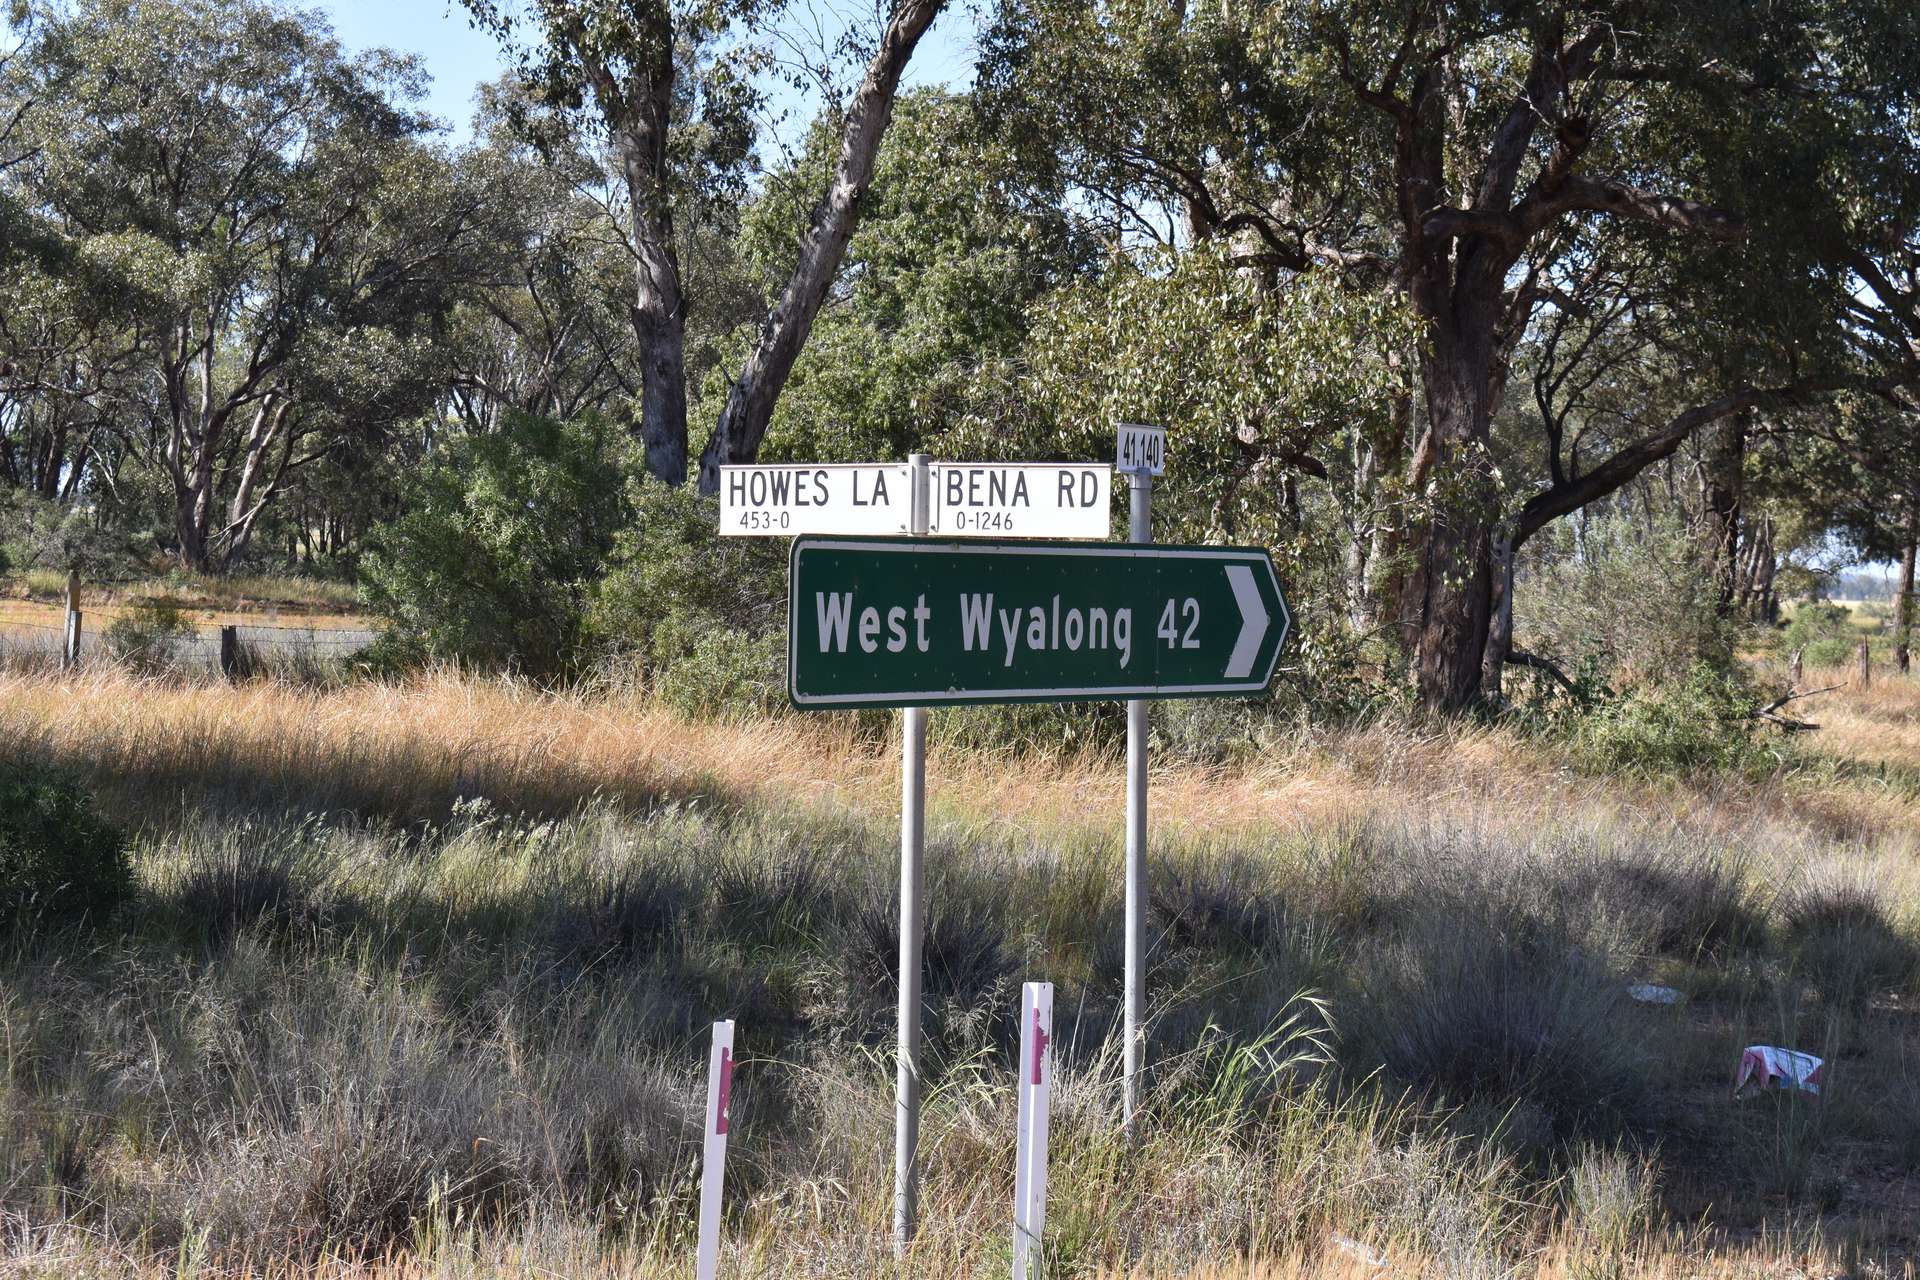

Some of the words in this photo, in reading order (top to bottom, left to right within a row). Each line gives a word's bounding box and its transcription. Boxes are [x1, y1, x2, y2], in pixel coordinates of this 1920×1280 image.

[1123, 432, 1159, 469] 41.140
[729, 470, 830, 507] HOWES
[852, 470, 890, 507] LA
[947, 470, 1030, 508] BENA
[1057, 471, 1099, 508] RD
[739, 511, 790, 529] 453-0
[956, 512, 1013, 531] 0-1246
[815, 591, 931, 653] West
[959, 592, 1132, 669] Wyalong
[1157, 597, 1201, 649] 42
